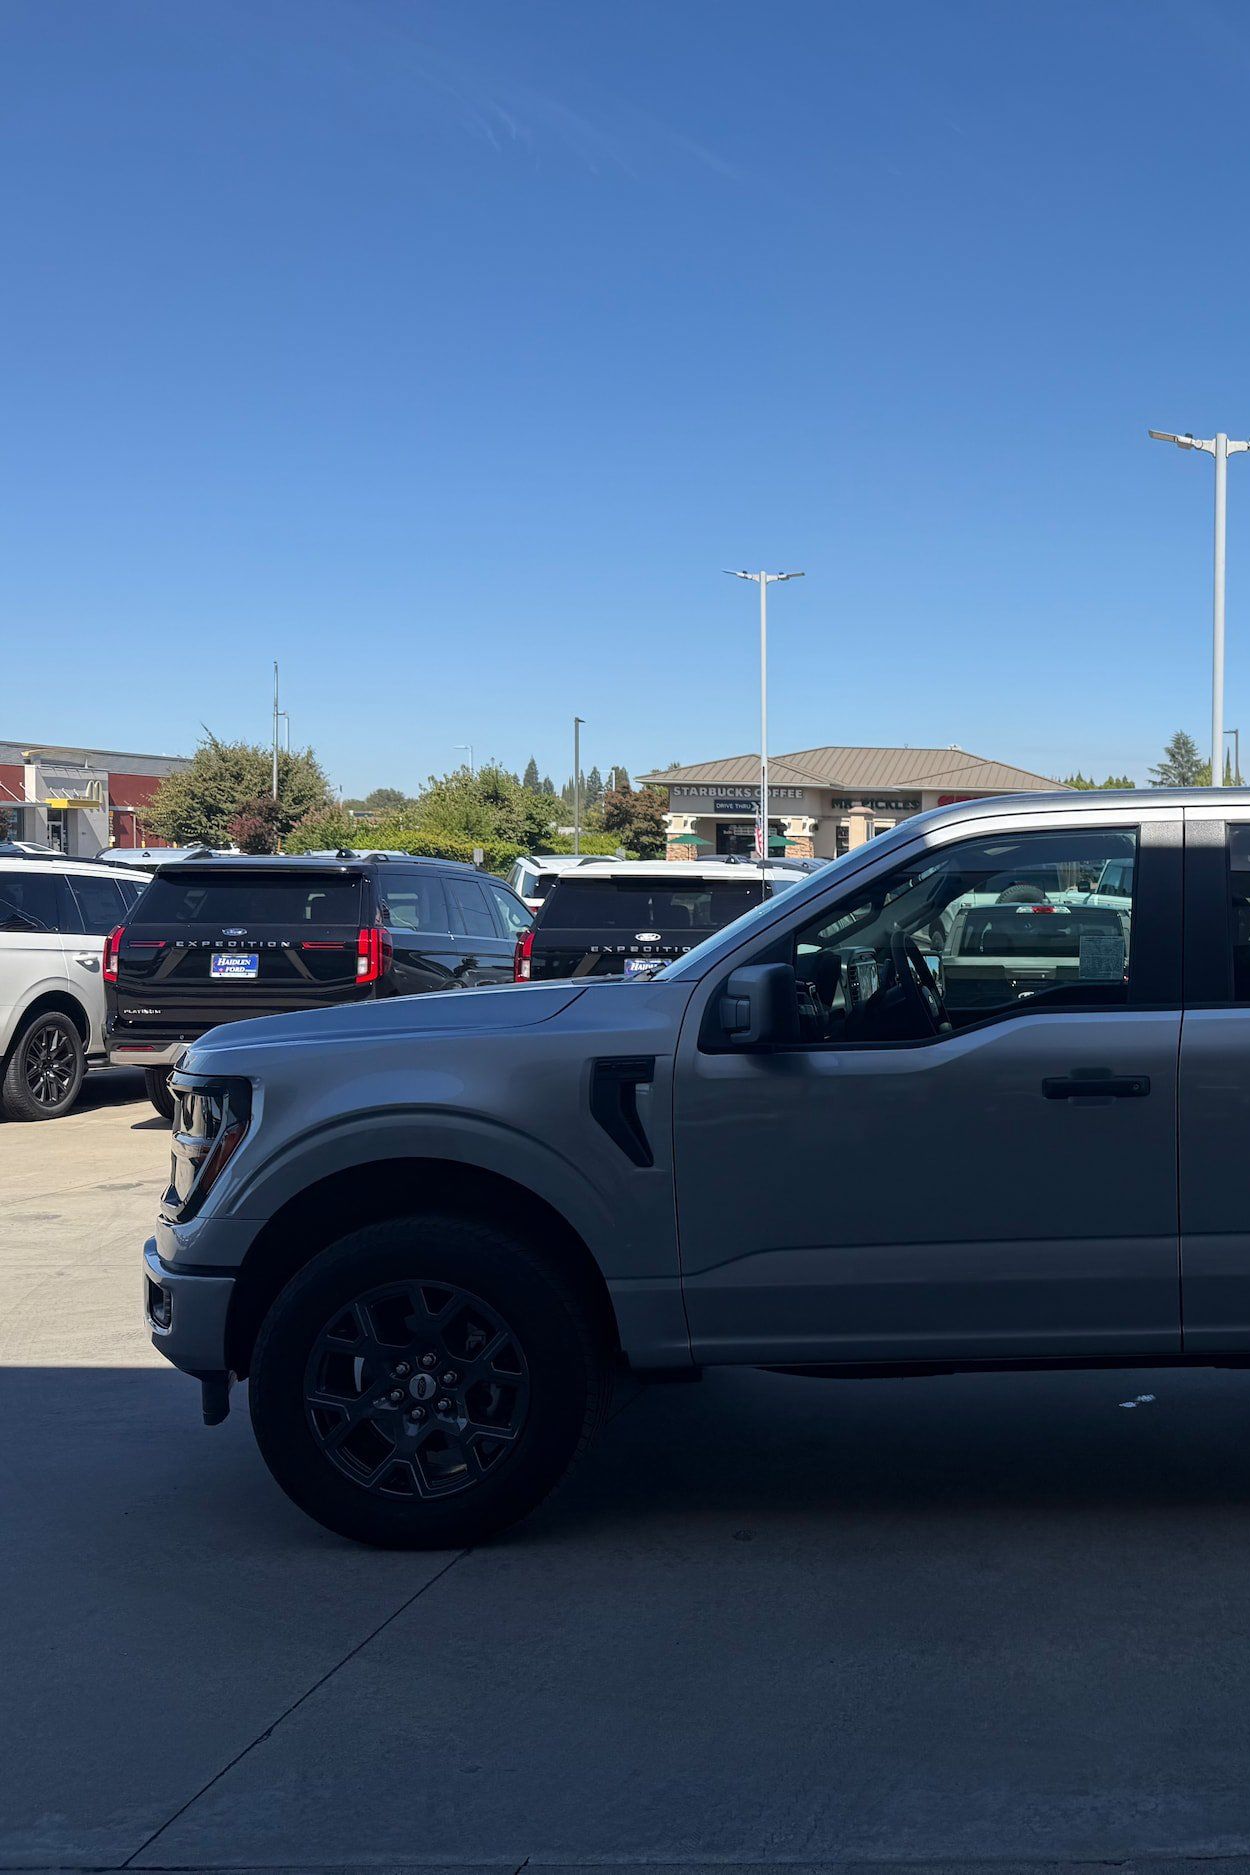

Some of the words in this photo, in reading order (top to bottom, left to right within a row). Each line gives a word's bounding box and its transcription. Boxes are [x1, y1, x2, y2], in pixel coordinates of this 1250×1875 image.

[673, 786, 752, 798] STARBUCKS
[735, 802, 751, 810] THRU
[175, 940, 291, 948] EXPEDITION
[590, 945, 692, 953] EXPEDITIO
